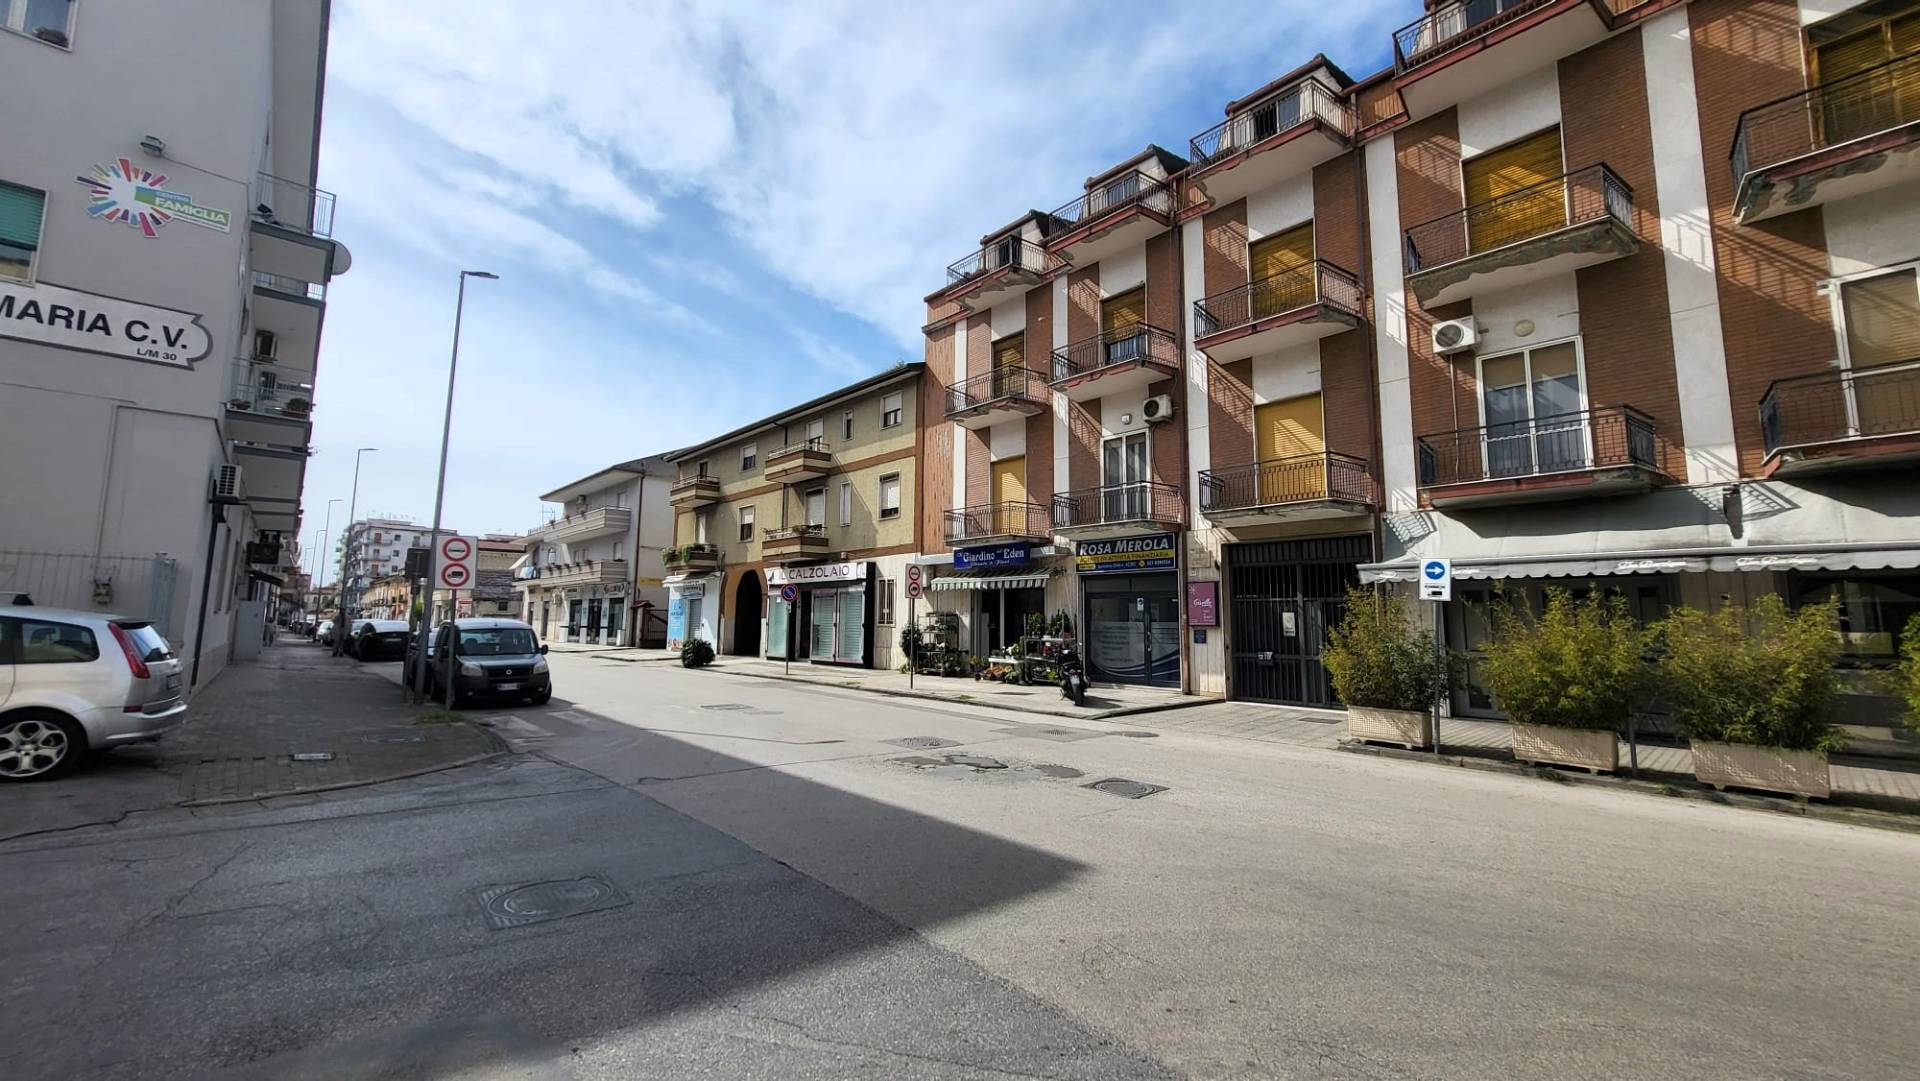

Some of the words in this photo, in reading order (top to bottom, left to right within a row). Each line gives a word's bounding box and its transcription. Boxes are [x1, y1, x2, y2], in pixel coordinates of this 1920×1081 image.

[155, 197, 226, 224] FAMIGLIA
[124, 320, 188, 350] C.V.
[136, 347, 159, 359] L/M
[162, 352, 177, 361] 30
[1080, 543, 1112, 555] ROSA
[1115, 538, 1169, 552] MEROLA
[963, 551, 996, 563] Giardino
[1003, 548, 1025, 559] Eden
[788, 565, 850, 580] CALZOLAIO
